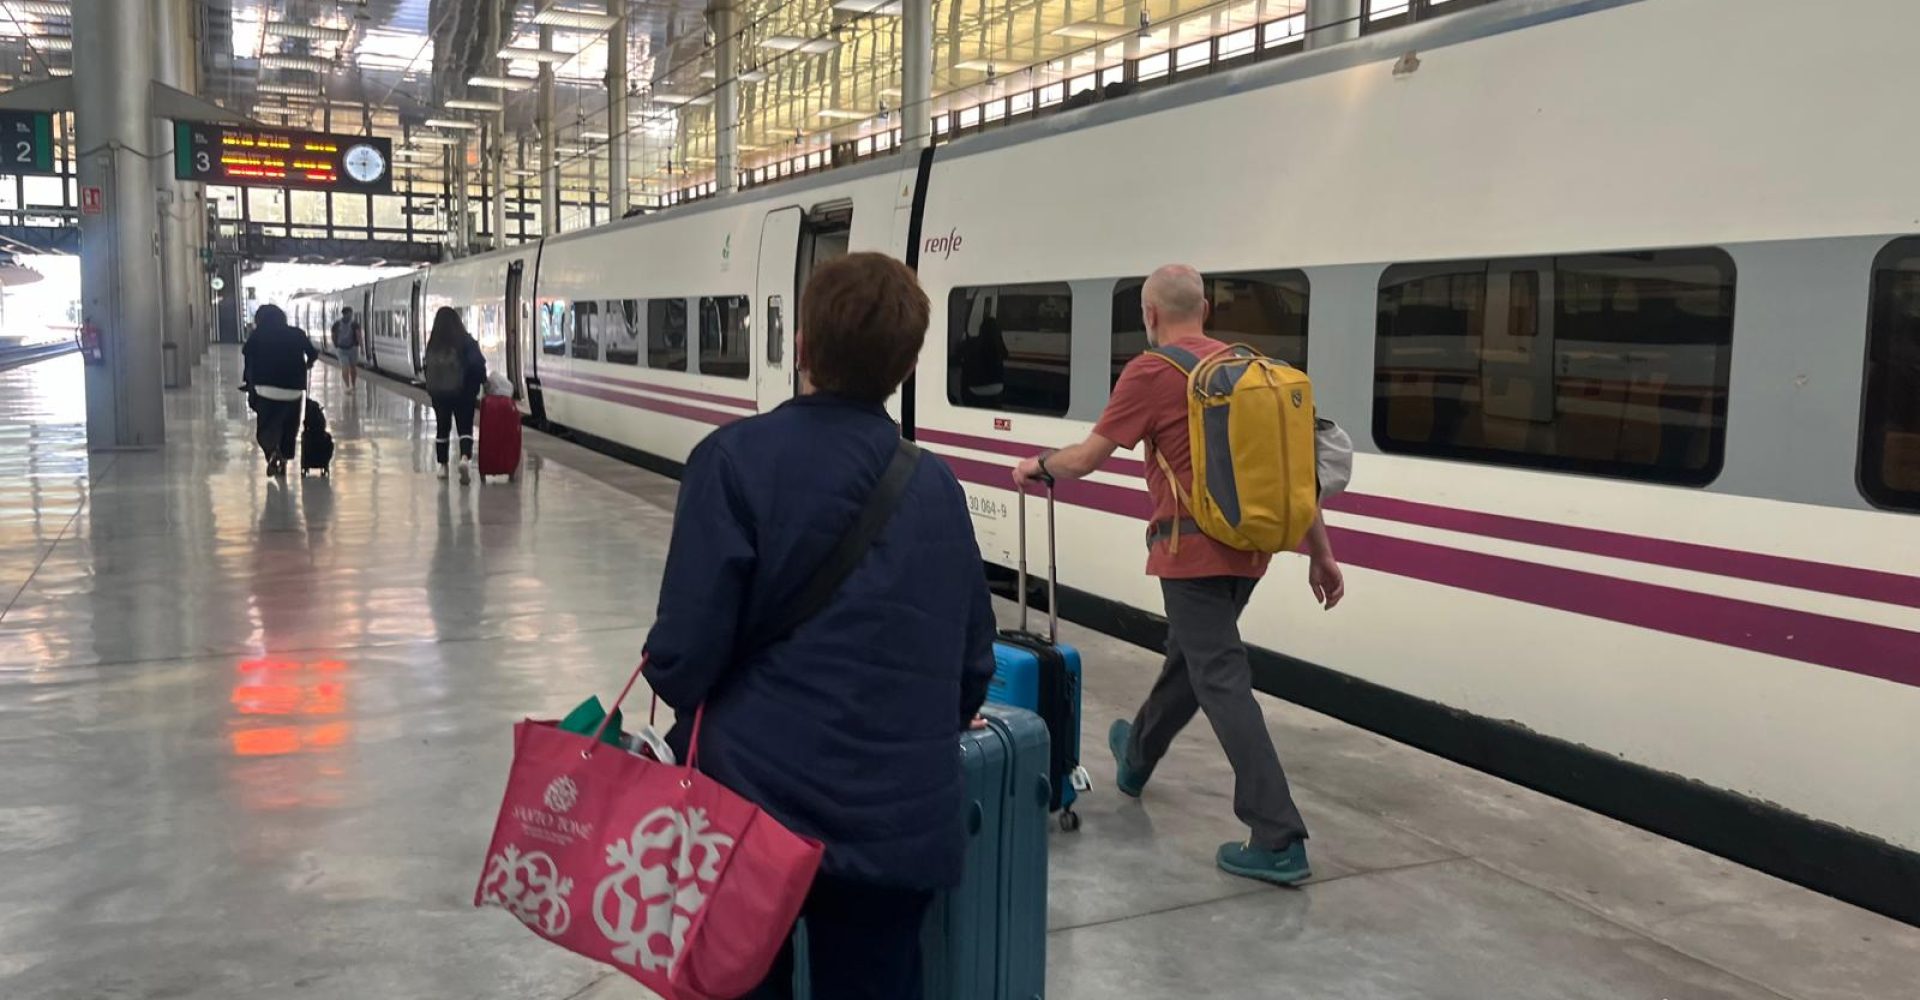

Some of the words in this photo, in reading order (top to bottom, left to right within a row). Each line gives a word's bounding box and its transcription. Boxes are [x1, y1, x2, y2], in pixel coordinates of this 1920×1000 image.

[16, 140, 31, 162] 2
[196, 150, 210, 172] 3
[924, 226, 963, 260] renfe
